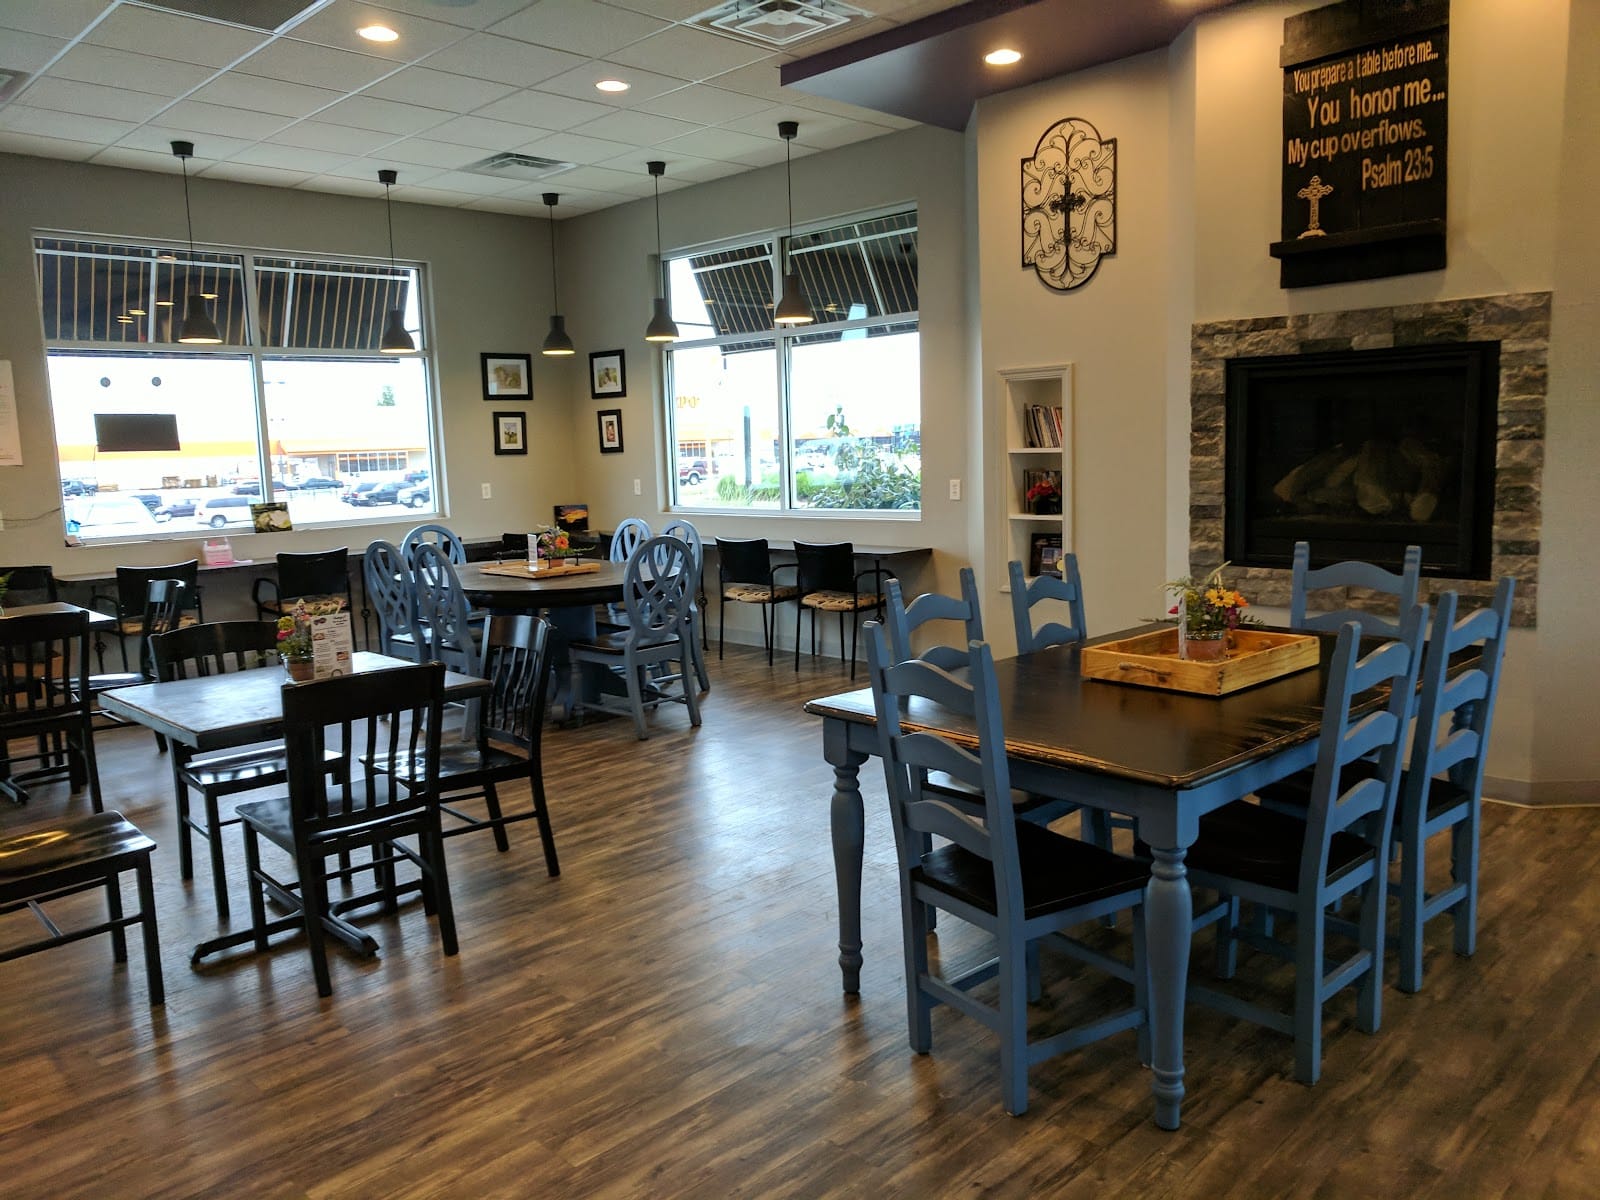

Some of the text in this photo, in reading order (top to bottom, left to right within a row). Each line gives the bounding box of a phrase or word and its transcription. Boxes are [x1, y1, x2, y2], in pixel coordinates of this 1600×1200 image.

[1294, 69, 1310, 94] You
[1311, 62, 1346, 96] prepare
[1347, 60, 1353, 80] a
[1356, 50, 1381, 78] table
[1382, 44, 1415, 72] before
[1308, 78, 1445, 128] You honor me...
[1288, 118, 1427, 168] My cup overflows.
[1362, 145, 1434, 191] Psalm 23:5
